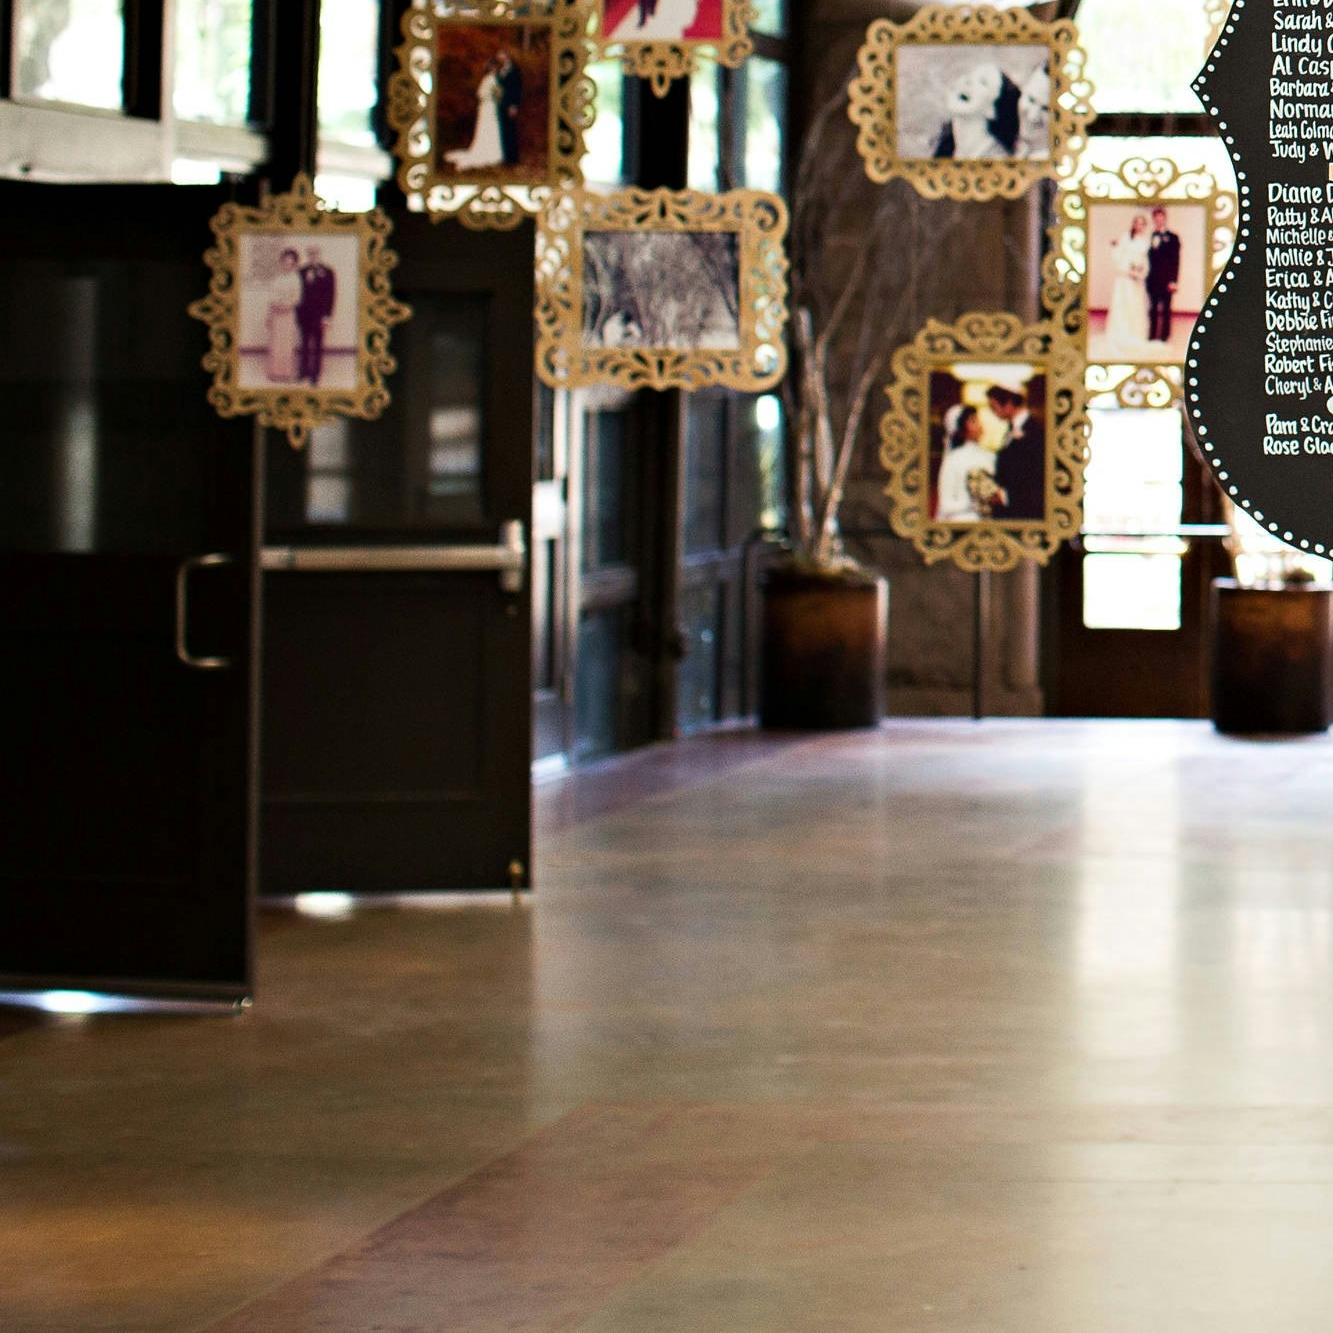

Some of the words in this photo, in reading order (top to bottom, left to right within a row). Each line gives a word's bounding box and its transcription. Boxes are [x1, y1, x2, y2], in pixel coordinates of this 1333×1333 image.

[1271, 31, 1323, 58] Lindy
[1267, 182, 1323, 204] Diane
[1264, 353, 1315, 374] Robert
[1262, 435, 1300, 456] Rose
